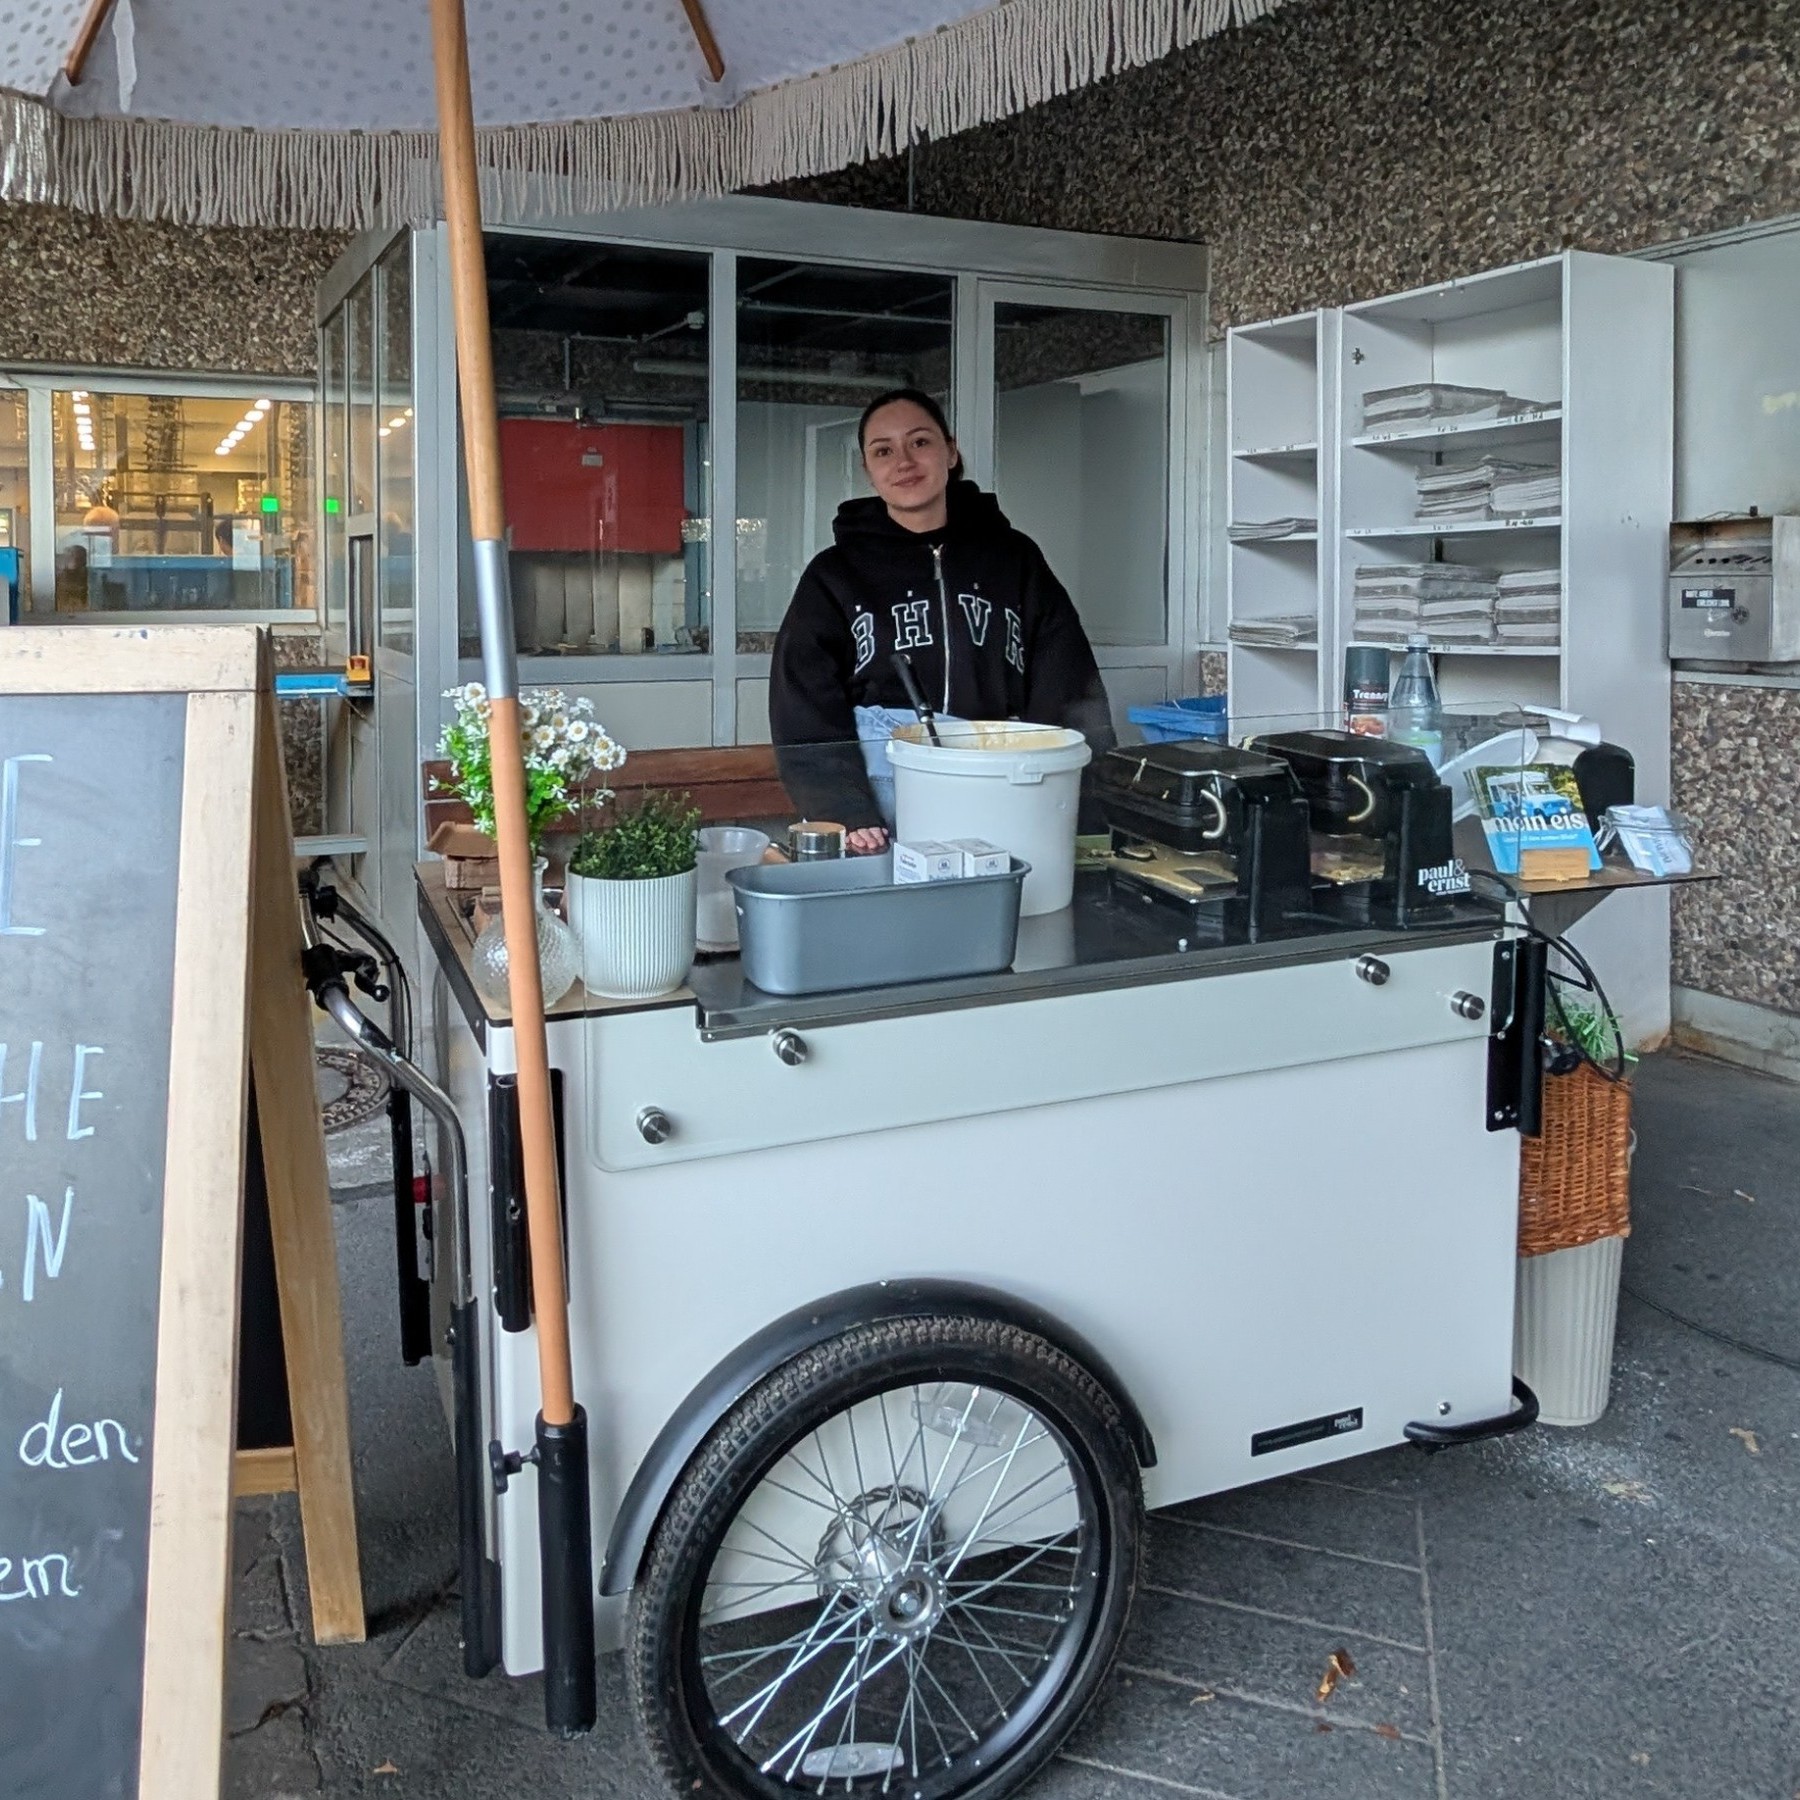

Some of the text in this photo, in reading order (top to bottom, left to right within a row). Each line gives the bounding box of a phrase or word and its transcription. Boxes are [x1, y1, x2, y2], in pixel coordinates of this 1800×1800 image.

[851, 594, 1024, 675] BHVR
[1494, 809, 1549, 833] mein
[1427, 872, 1471, 893] ernst
[0, 1186, 75, 1302] N
[19, 1387, 139, 1469] den
